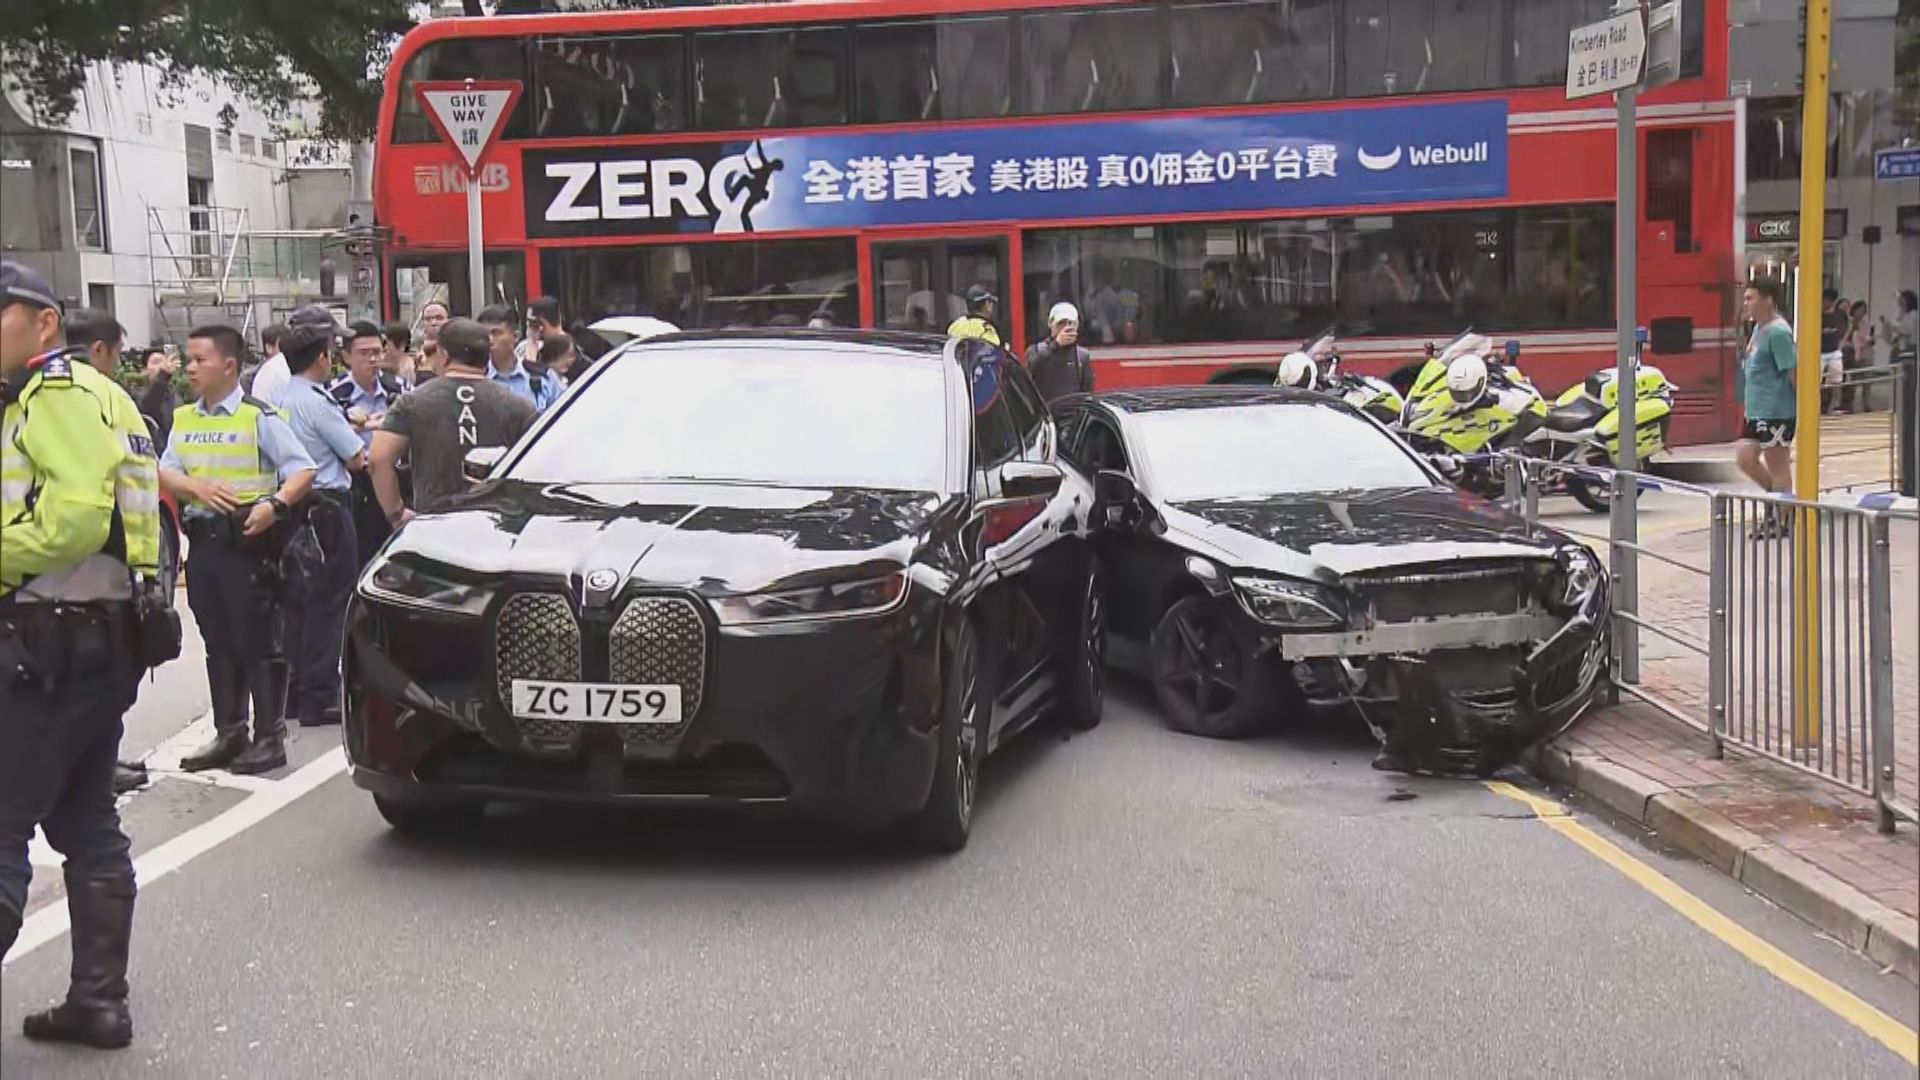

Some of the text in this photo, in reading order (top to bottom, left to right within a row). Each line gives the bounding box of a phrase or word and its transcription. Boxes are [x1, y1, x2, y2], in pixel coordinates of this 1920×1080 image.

[450, 95, 488, 107] GIVE
[452, 110, 486, 122] WAY
[1409, 142, 1489, 167] Webull
[441, 163, 510, 192] KB
[545, 154, 775, 222] ZERO
[802, 144, 1338, 203] 全港首家 美港股 真0佣金0平台費
[456, 385, 478, 446] CAN
[192, 431, 224, 444] POLICE
[527, 685, 667, 718] ZC 1759
